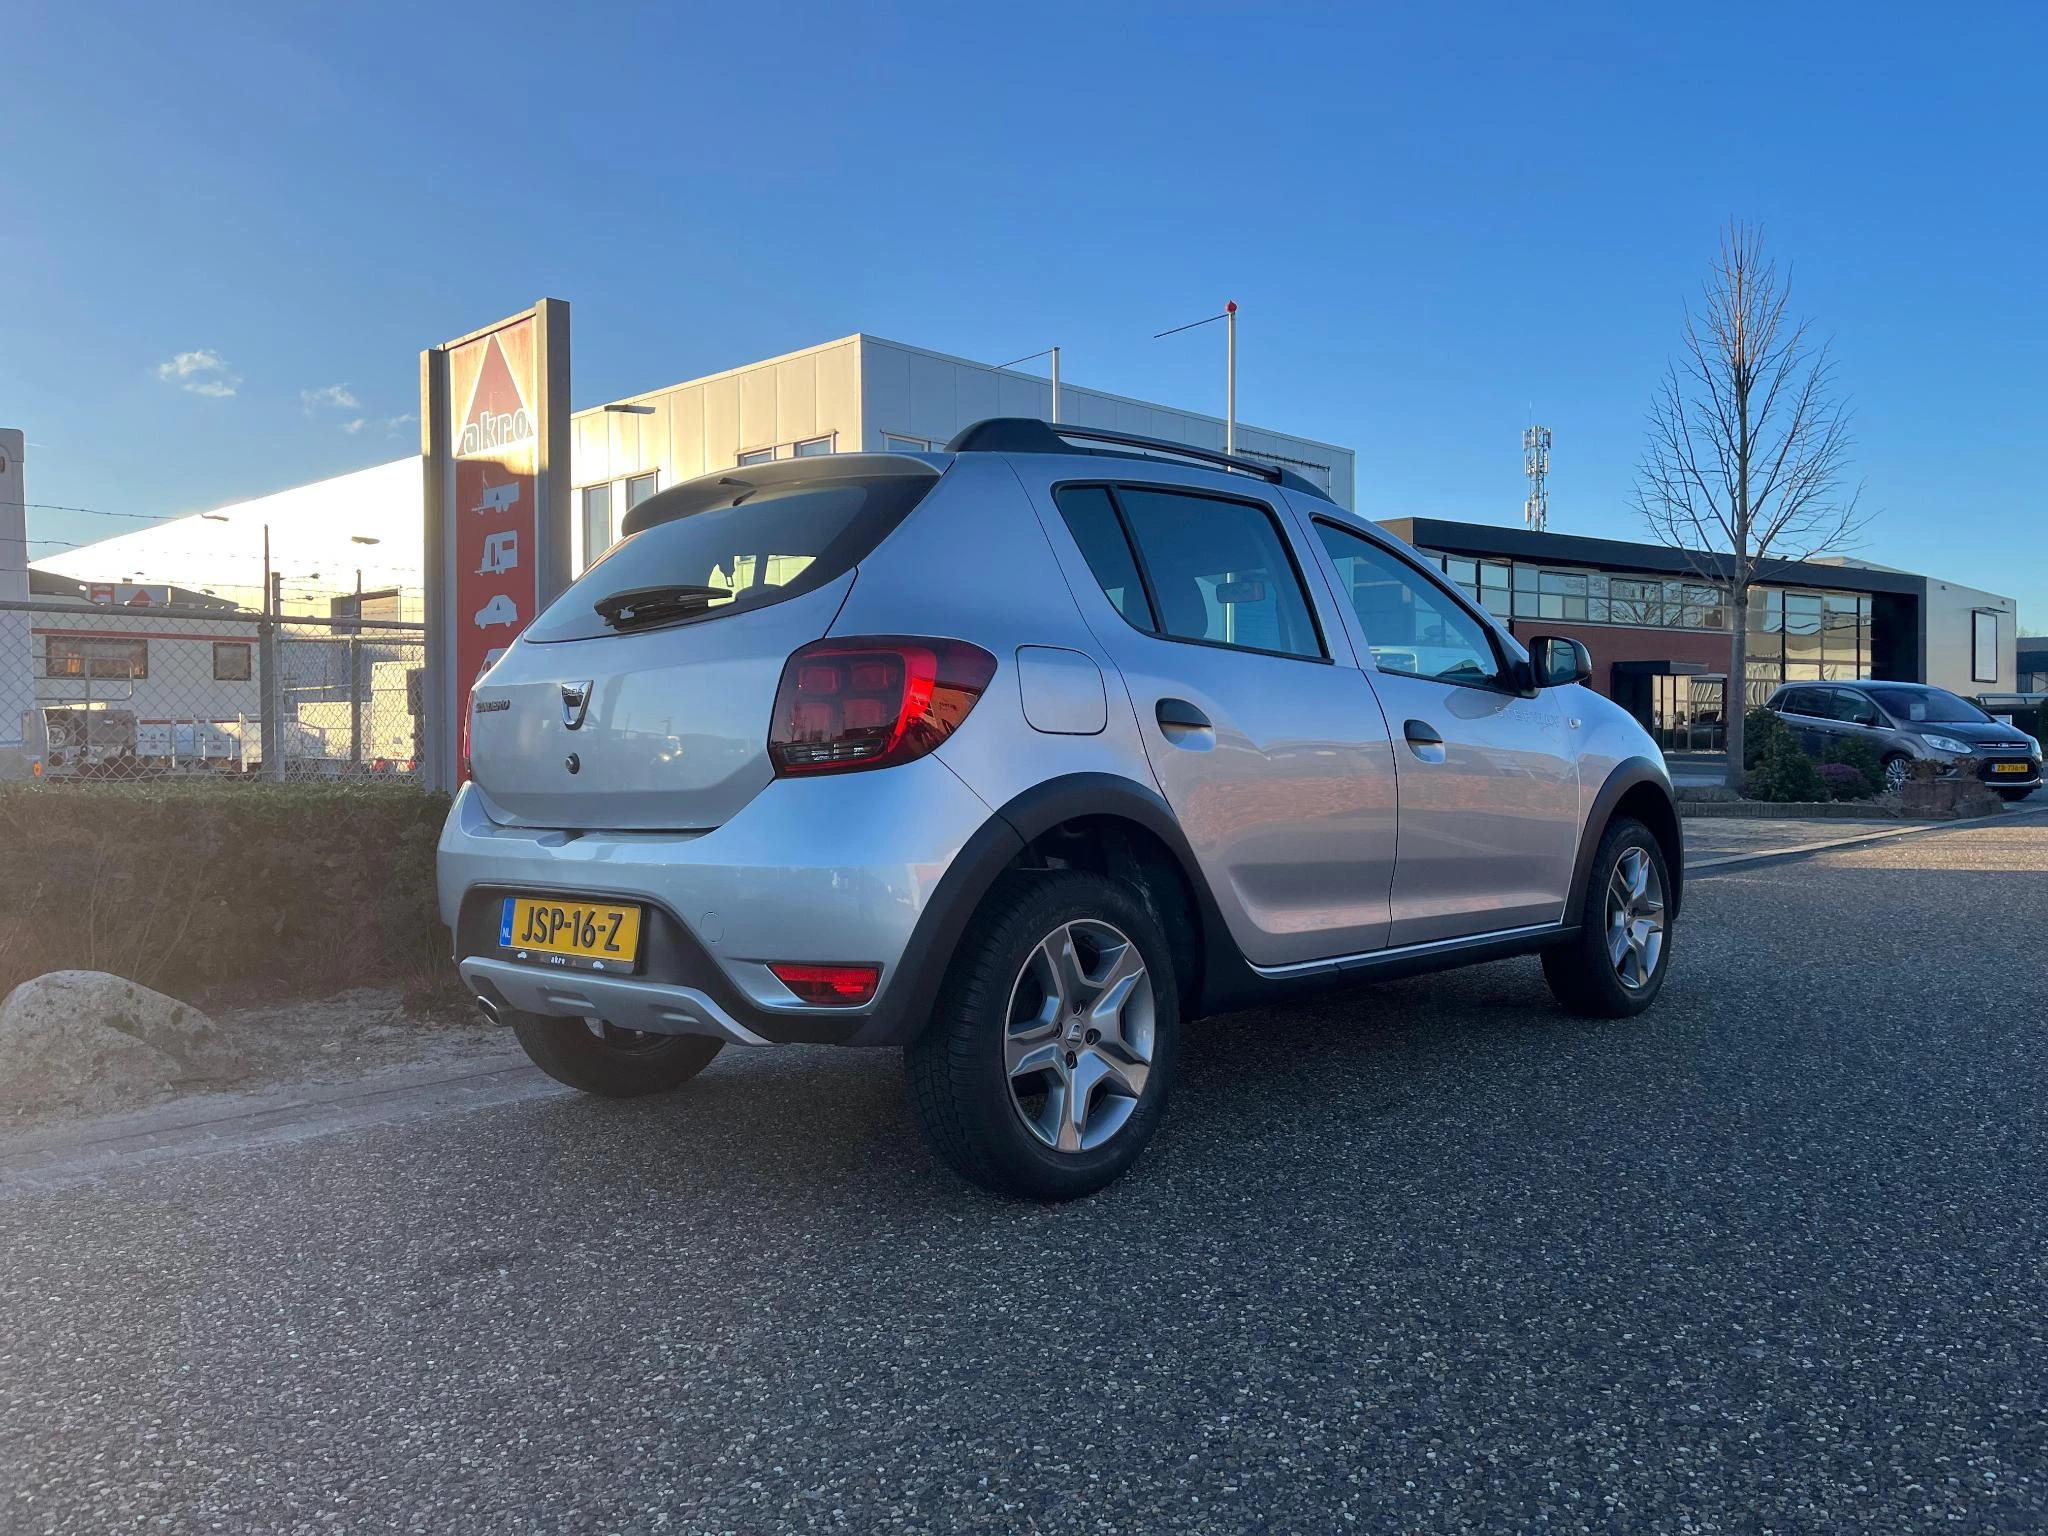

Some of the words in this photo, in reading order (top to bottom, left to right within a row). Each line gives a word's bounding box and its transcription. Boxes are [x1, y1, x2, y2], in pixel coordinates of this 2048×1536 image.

[463, 408, 528, 455] akro
[502, 928, 511, 938] NL
[521, 906, 623, 952] JSP-16-Z
